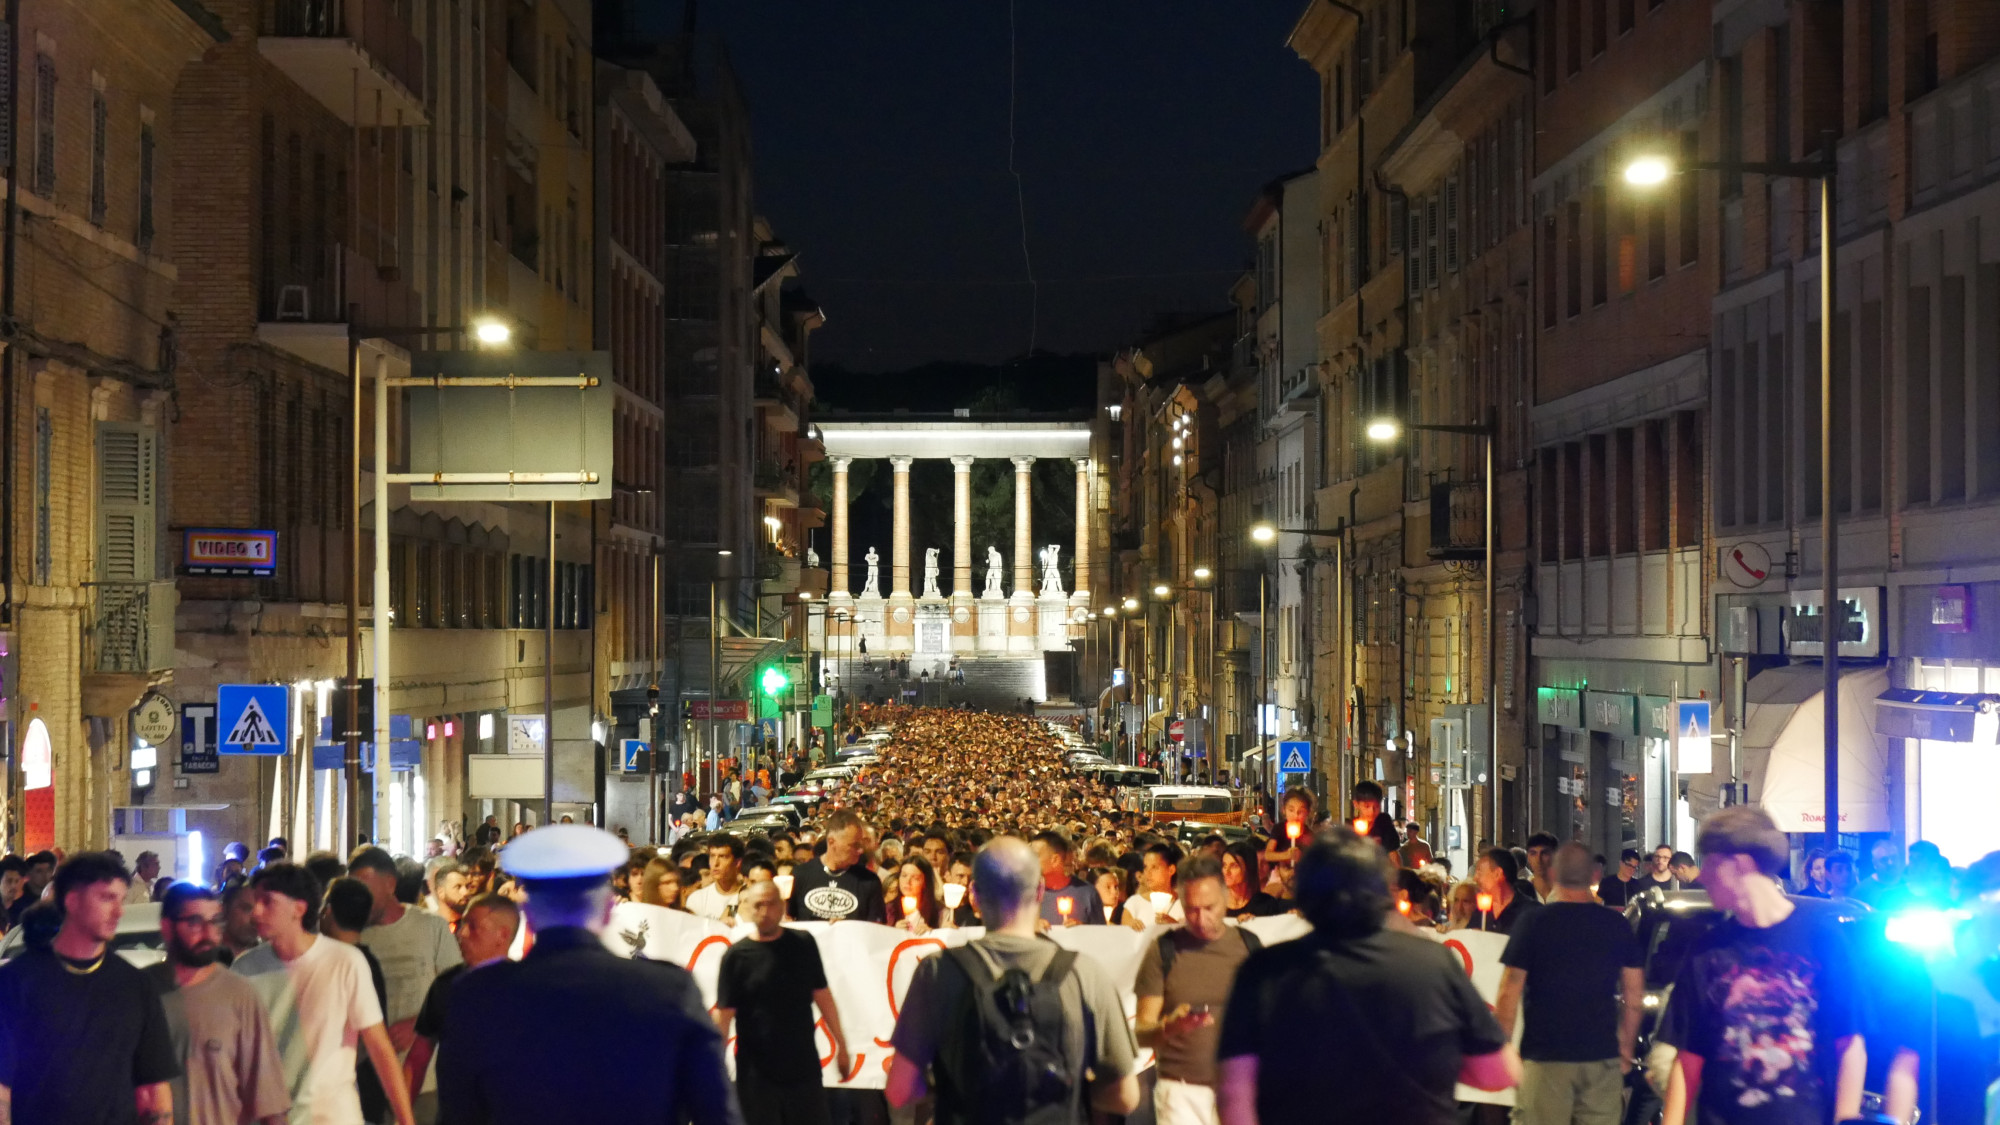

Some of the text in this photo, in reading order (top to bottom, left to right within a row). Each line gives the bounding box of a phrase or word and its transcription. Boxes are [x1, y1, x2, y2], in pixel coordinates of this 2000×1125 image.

[198, 541, 263, 557] VIDEO 1
[185, 707, 214, 754] T
